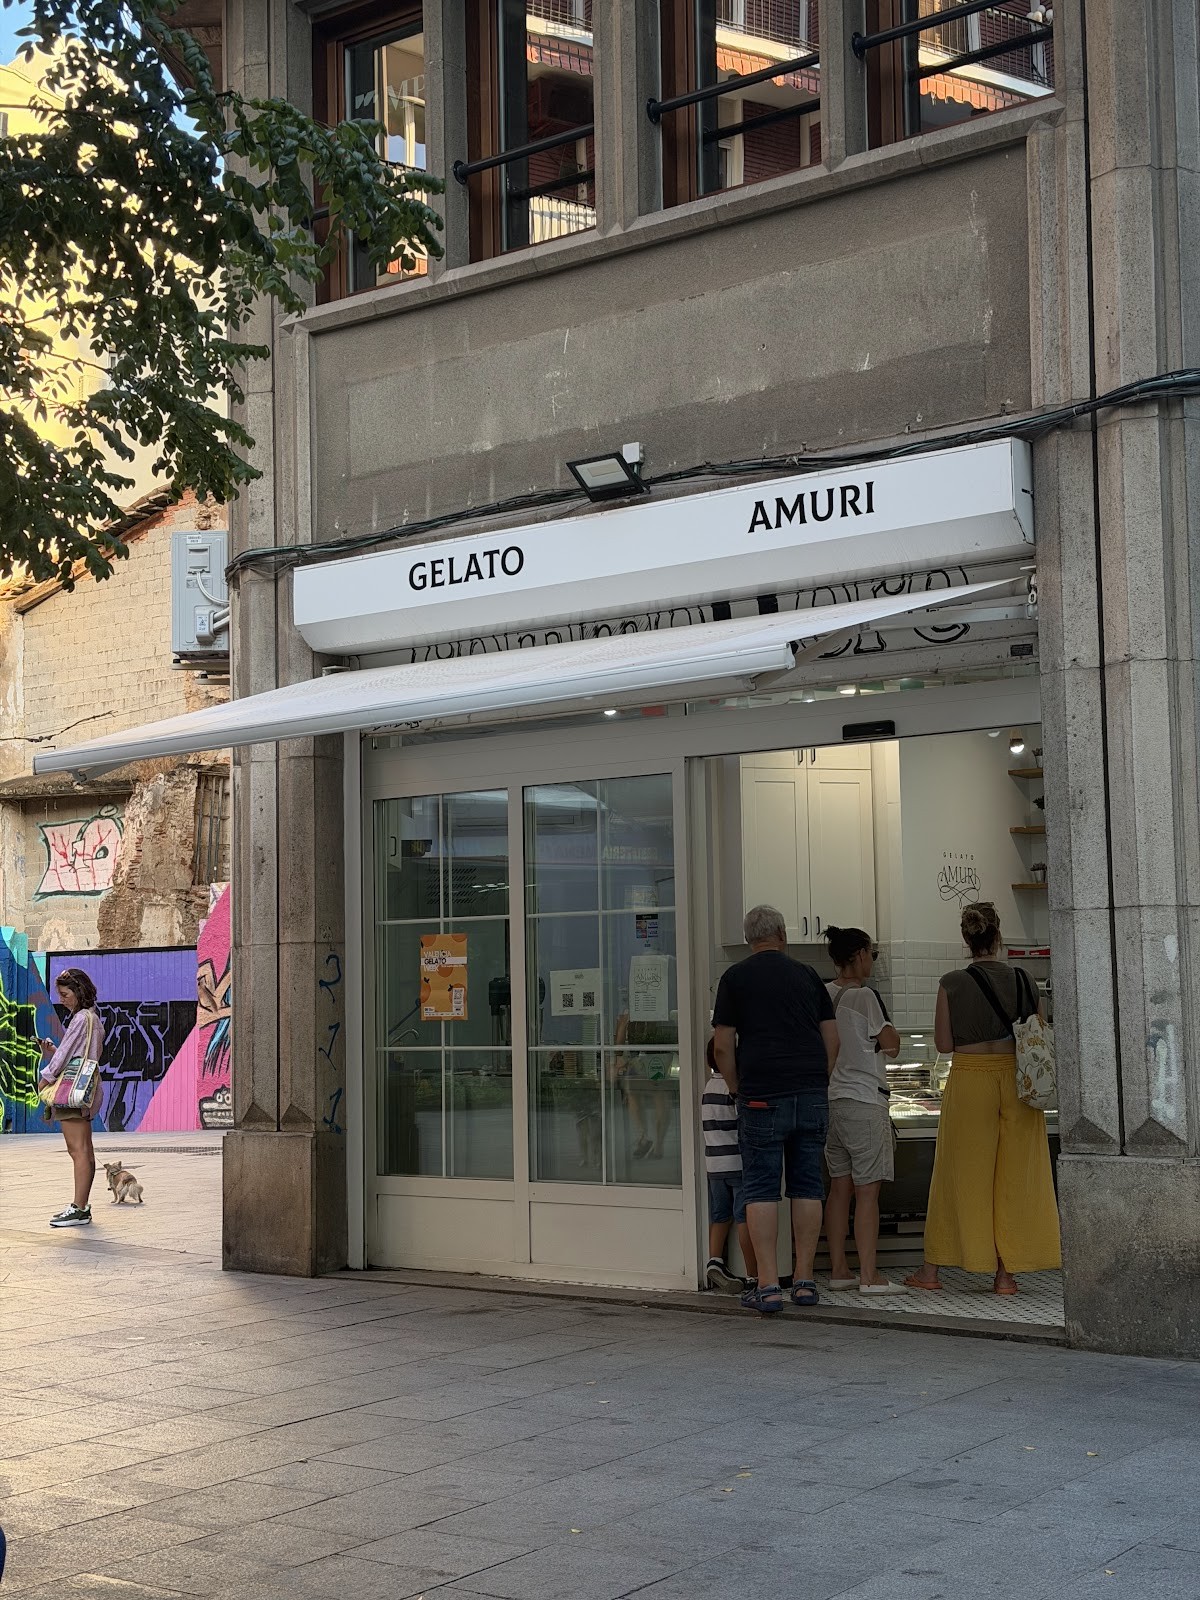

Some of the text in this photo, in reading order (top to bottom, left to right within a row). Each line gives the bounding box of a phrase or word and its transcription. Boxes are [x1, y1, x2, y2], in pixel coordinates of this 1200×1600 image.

[408, 480, 876, 591] GELATO AMURI
[943, 852, 975, 861] GELATO
[939, 865, 978, 886] AMURI
[424, 957, 446, 965] GELATO
